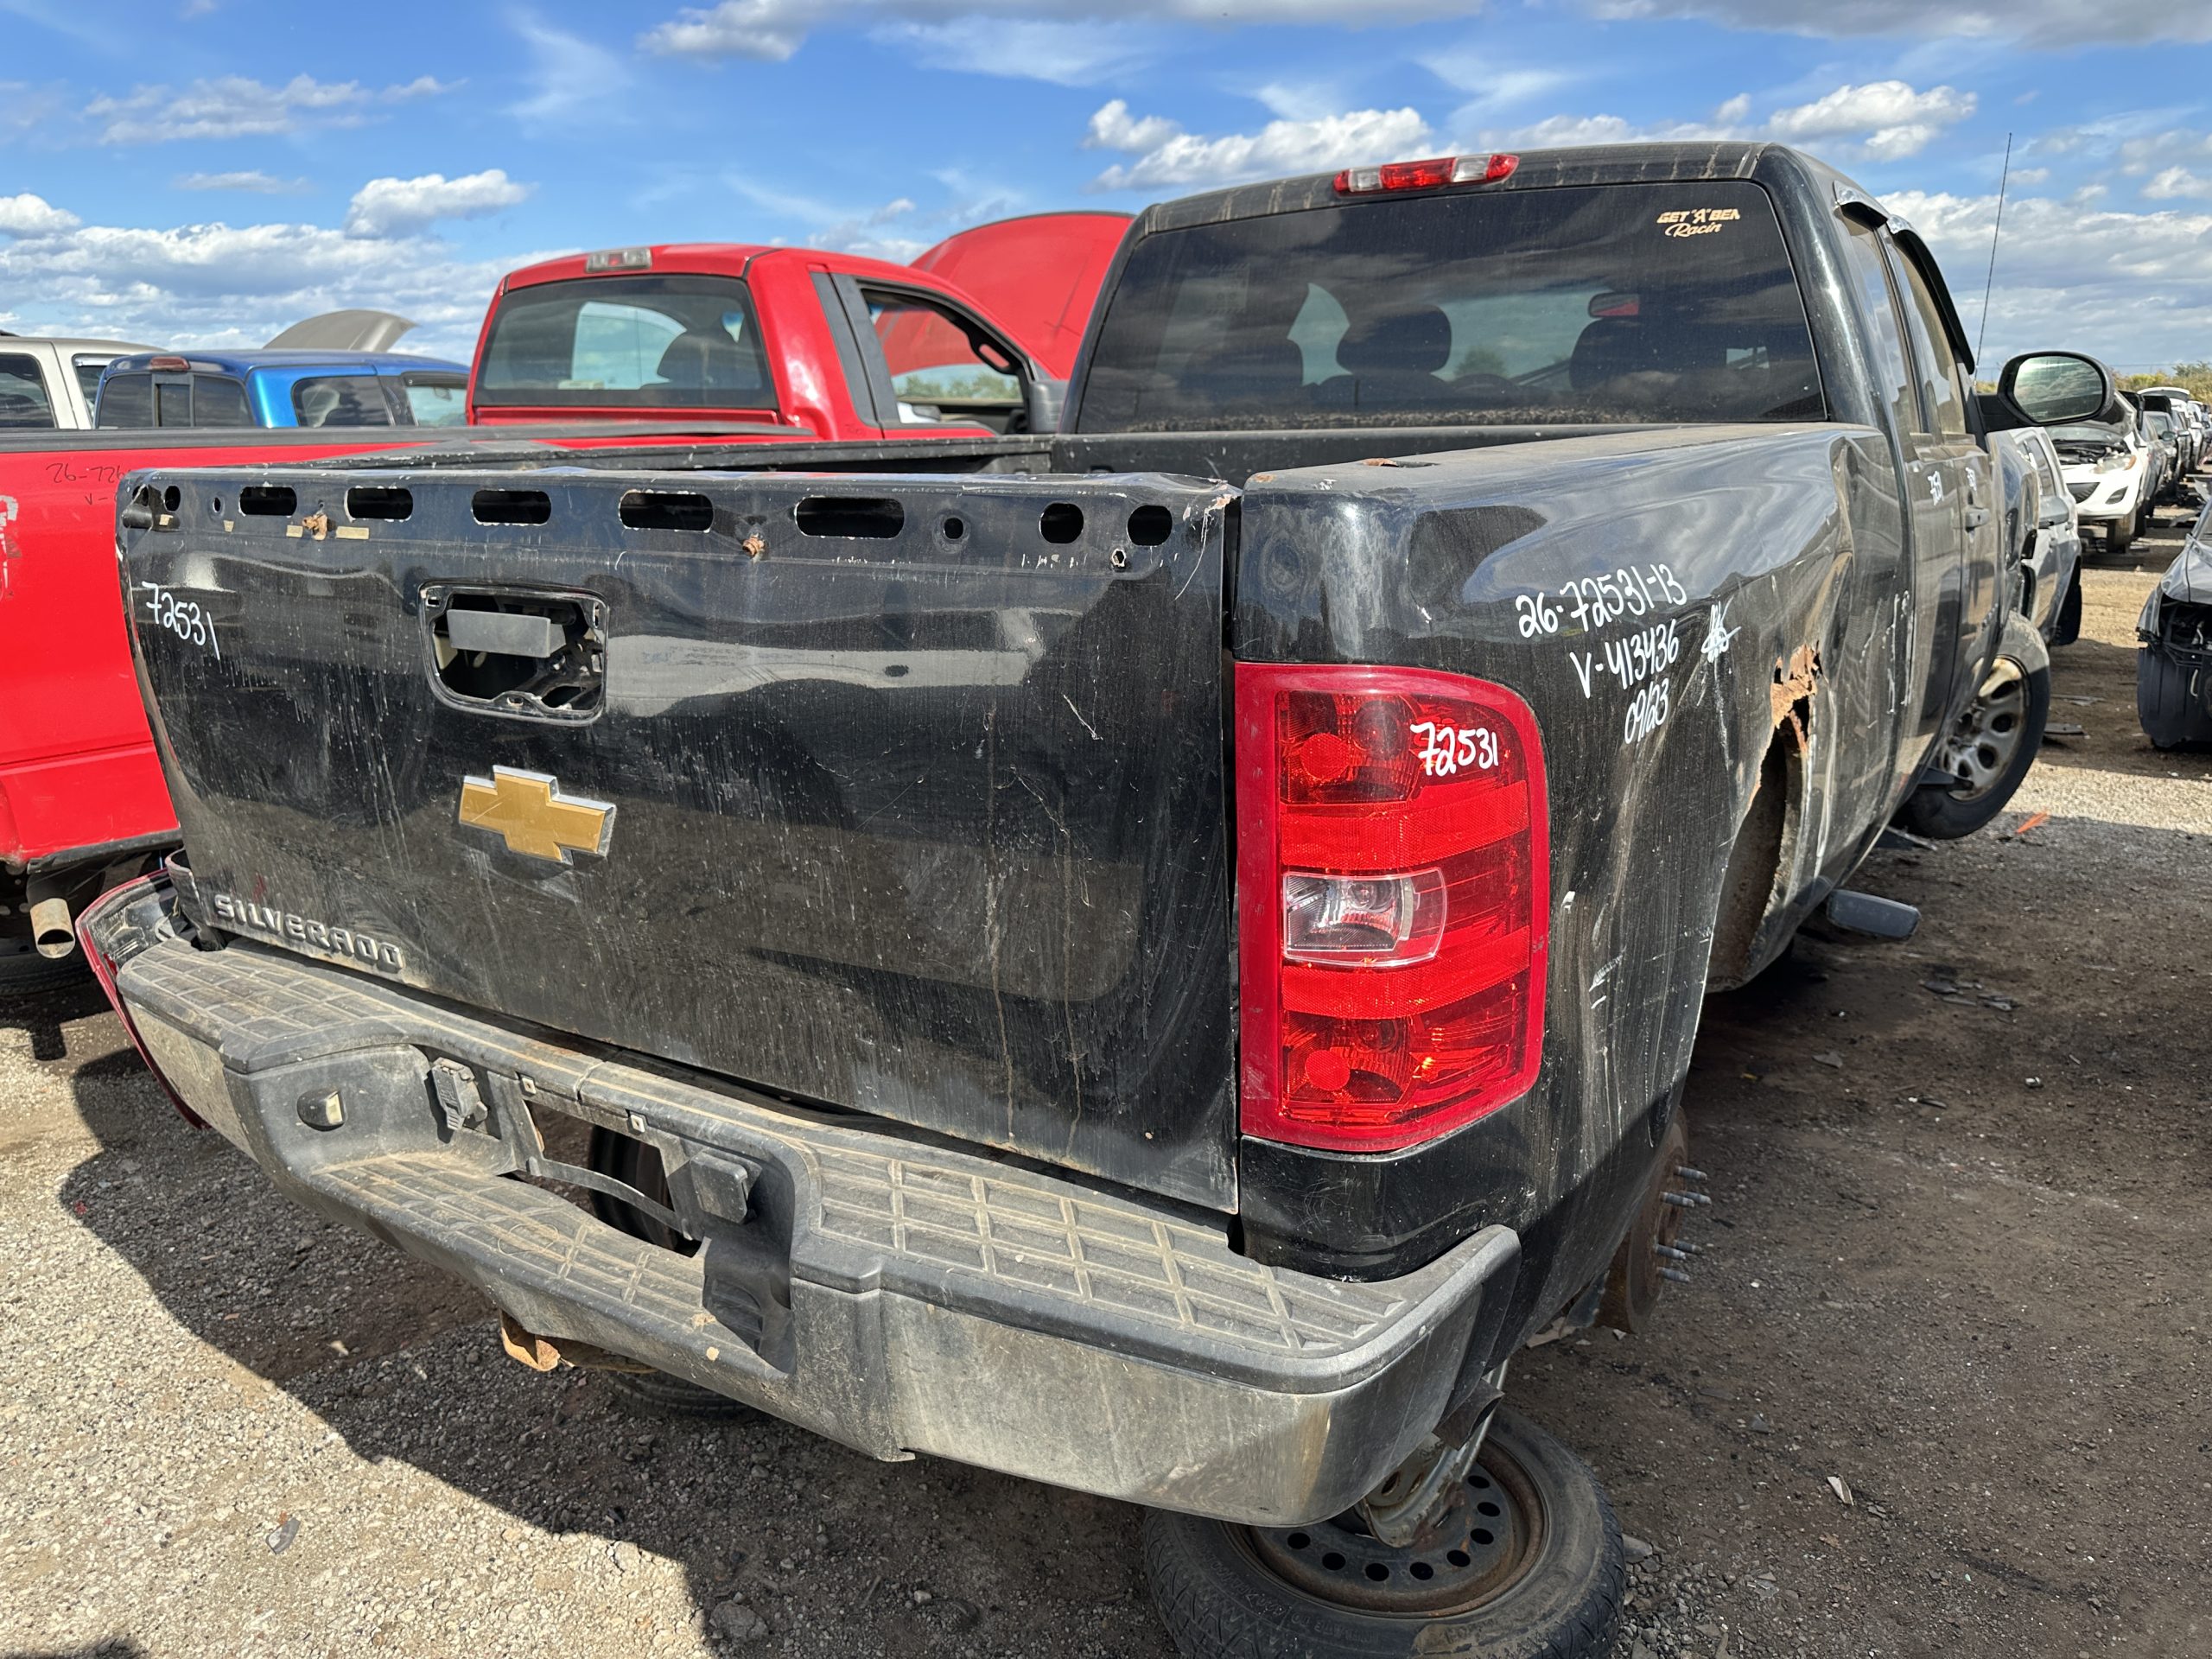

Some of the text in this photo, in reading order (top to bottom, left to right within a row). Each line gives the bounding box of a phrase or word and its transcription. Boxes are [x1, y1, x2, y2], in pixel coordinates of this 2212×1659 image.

[1656, 211, 1690, 223] GET
[1664, 222, 1722, 238] Racin
[46, 463, 132, 484] 26-726
[142, 581, 220, 661] 72531
[1569, 619, 1680, 699] V-413436
[1409, 721, 1499, 777] 72531
[214, 893, 405, 971] SILVERADO
